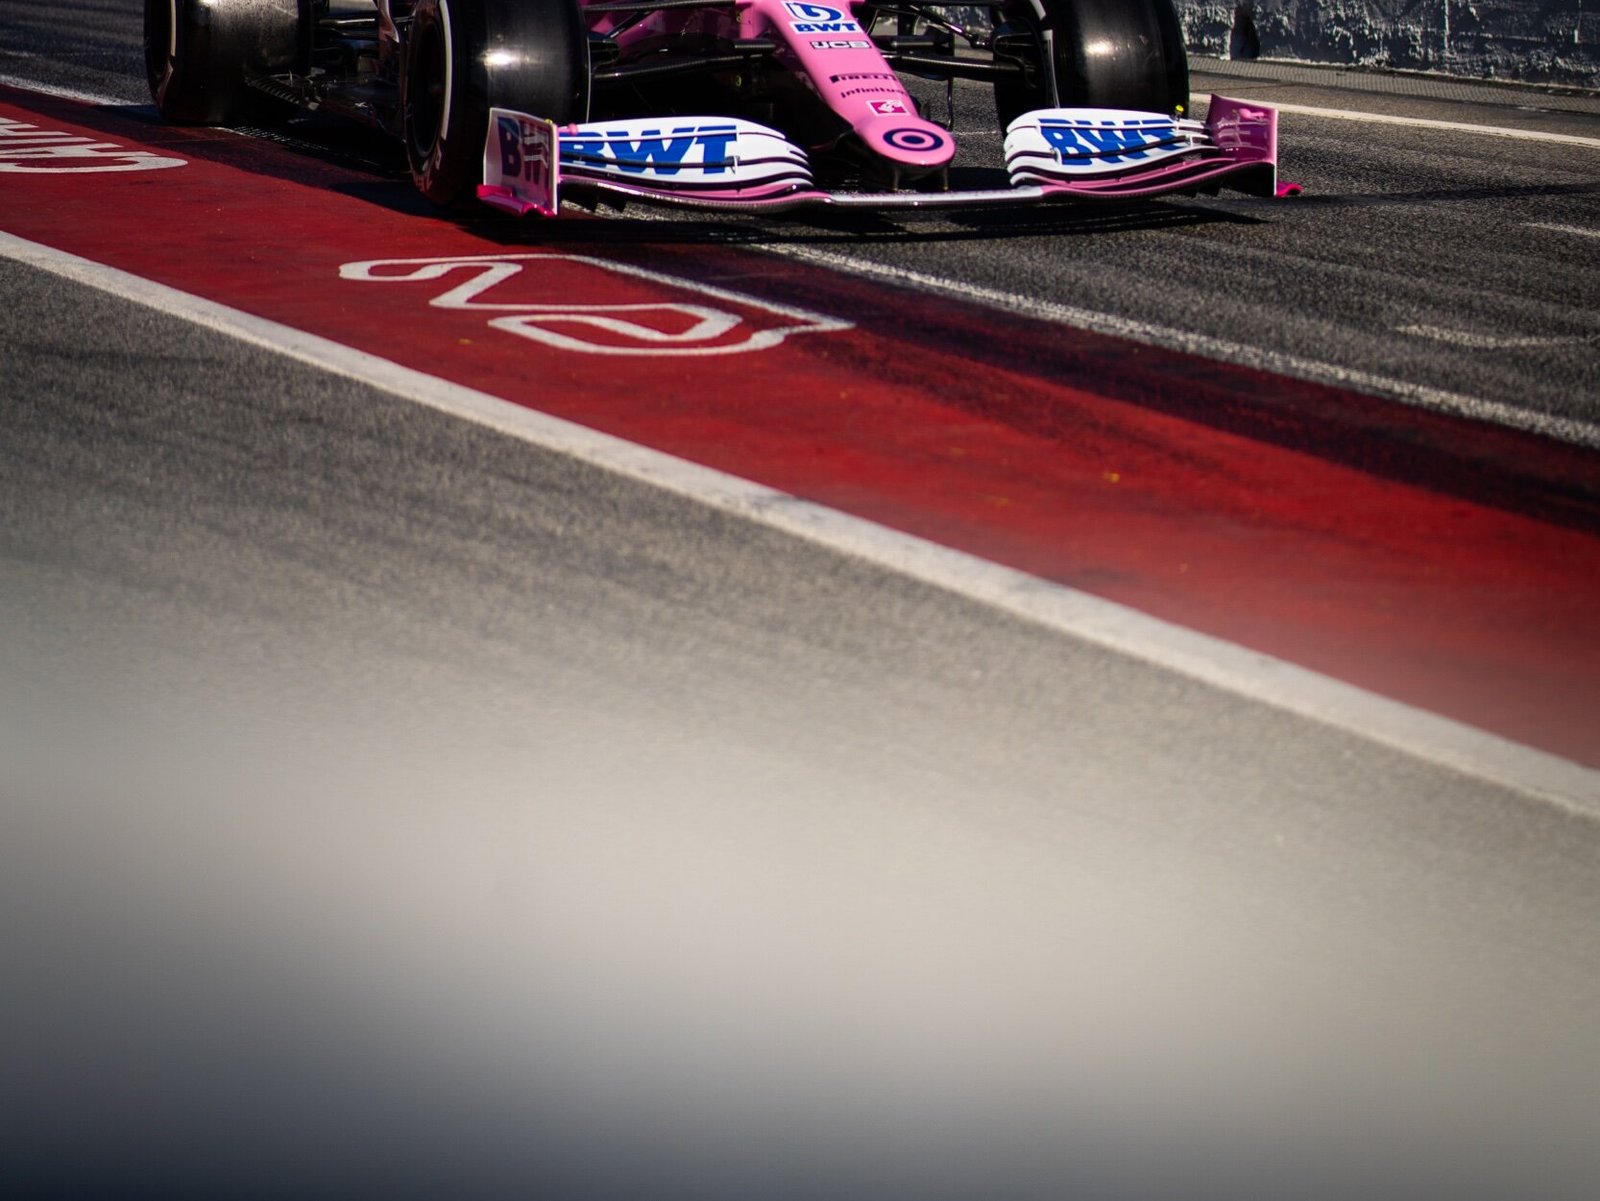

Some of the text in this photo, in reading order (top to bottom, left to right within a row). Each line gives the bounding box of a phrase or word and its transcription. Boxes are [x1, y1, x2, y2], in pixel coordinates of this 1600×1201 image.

[795, 23, 856, 32] BWT
[559, 125, 738, 174] BWT
[1038, 118, 1181, 165] BWT
